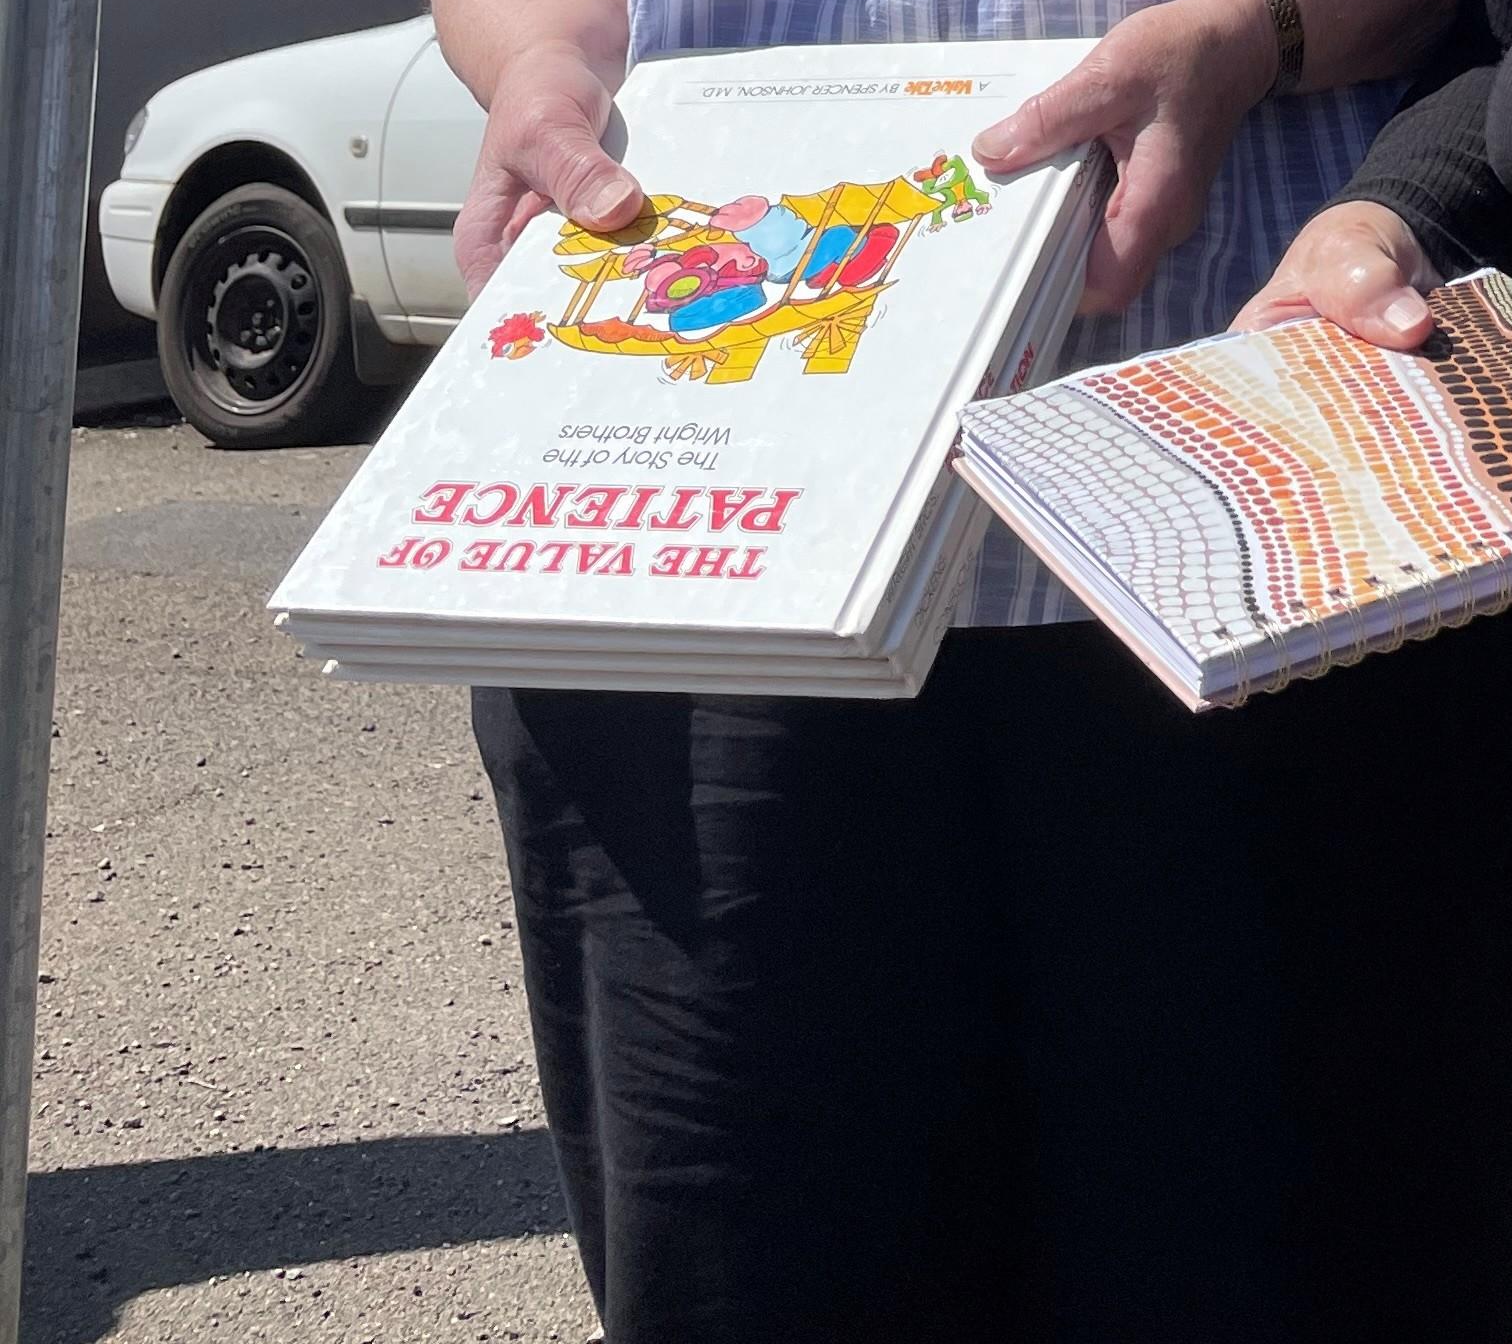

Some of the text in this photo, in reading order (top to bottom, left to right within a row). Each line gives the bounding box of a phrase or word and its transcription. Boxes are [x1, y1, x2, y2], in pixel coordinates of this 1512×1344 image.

[811, 83, 878, 95] SPENCER
[880, 83, 900, 95] BY
[558, 423, 732, 447] Wright Brothers
[617, 447, 674, 471] Story
[678, 450, 719, 471] The
[411, 480, 805, 535] PATIENCE
[376, 536, 770, 580] THE VALUE OF
